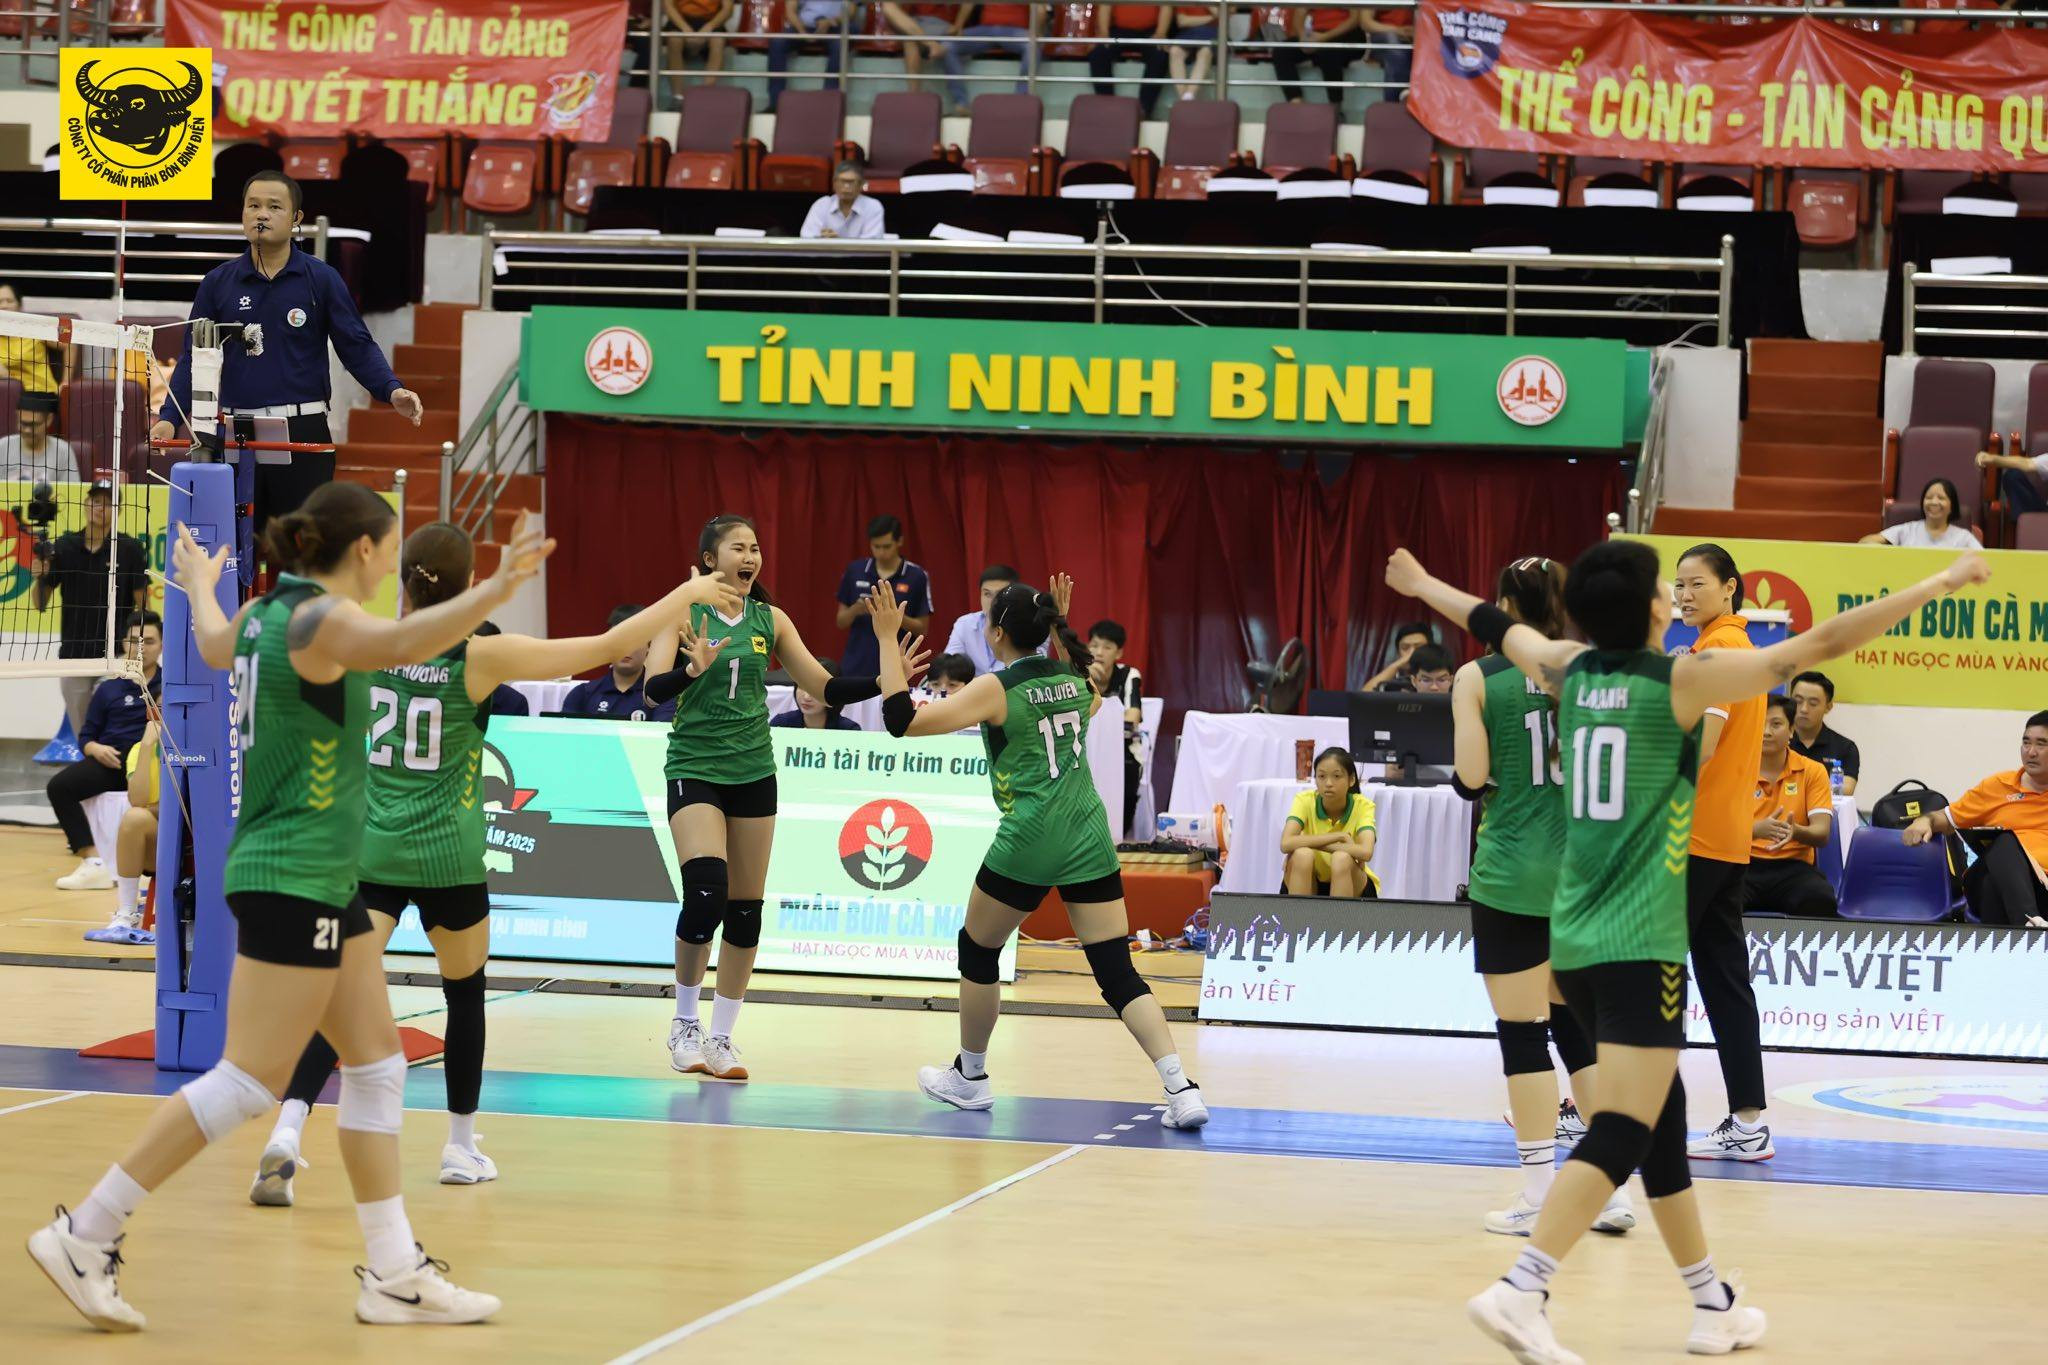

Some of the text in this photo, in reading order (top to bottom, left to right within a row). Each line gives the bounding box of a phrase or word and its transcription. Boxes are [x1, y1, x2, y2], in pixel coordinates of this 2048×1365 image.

[288, 5, 376, 53] CÔNG
[408, 9, 471, 56] TÂN
[480, 6, 570, 58] CẢNG
[225, 65, 538, 128] QUYẾT THẮNG
[1497, 47, 1585, 135] THỂ
[1589, 64, 1715, 145] CÔNG
[1759, 68, 1846, 150] TÂN
[1860, 68, 1985, 151] CẢNG
[706, 324, 1433, 425] TỈNH NINH BÌNH
[1920, 591, 1976, 639] BÓN
[1984, 592, 2020, 641] CÀ
[729, 657, 740, 700] 1
[1855, 650, 1888, 669] HẠT
[1893, 652, 1950, 671] NGỌC
[1956, 650, 1997, 670] MÙA
[368, 685, 443, 771] 20
[1038, 710, 1082, 779] 17
[785, 746, 826, 768] Nhà
[834, 749, 860, 770] tài
[867, 751, 897, 776] trợ
[903, 752, 942, 774] kim
[1572, 726, 1627, 821] 10
[504, 832, 536, 854] 2025
[313, 917, 339, 950] 21
[824, 943, 871, 960] NGỌC
[1242, 979, 1296, 1004] VIỆT
[1763, 1007, 1826, 1031] nông
[1837, 1006, 1880, 1029] sản
[1890, 1009, 1945, 1035] VIỆT
